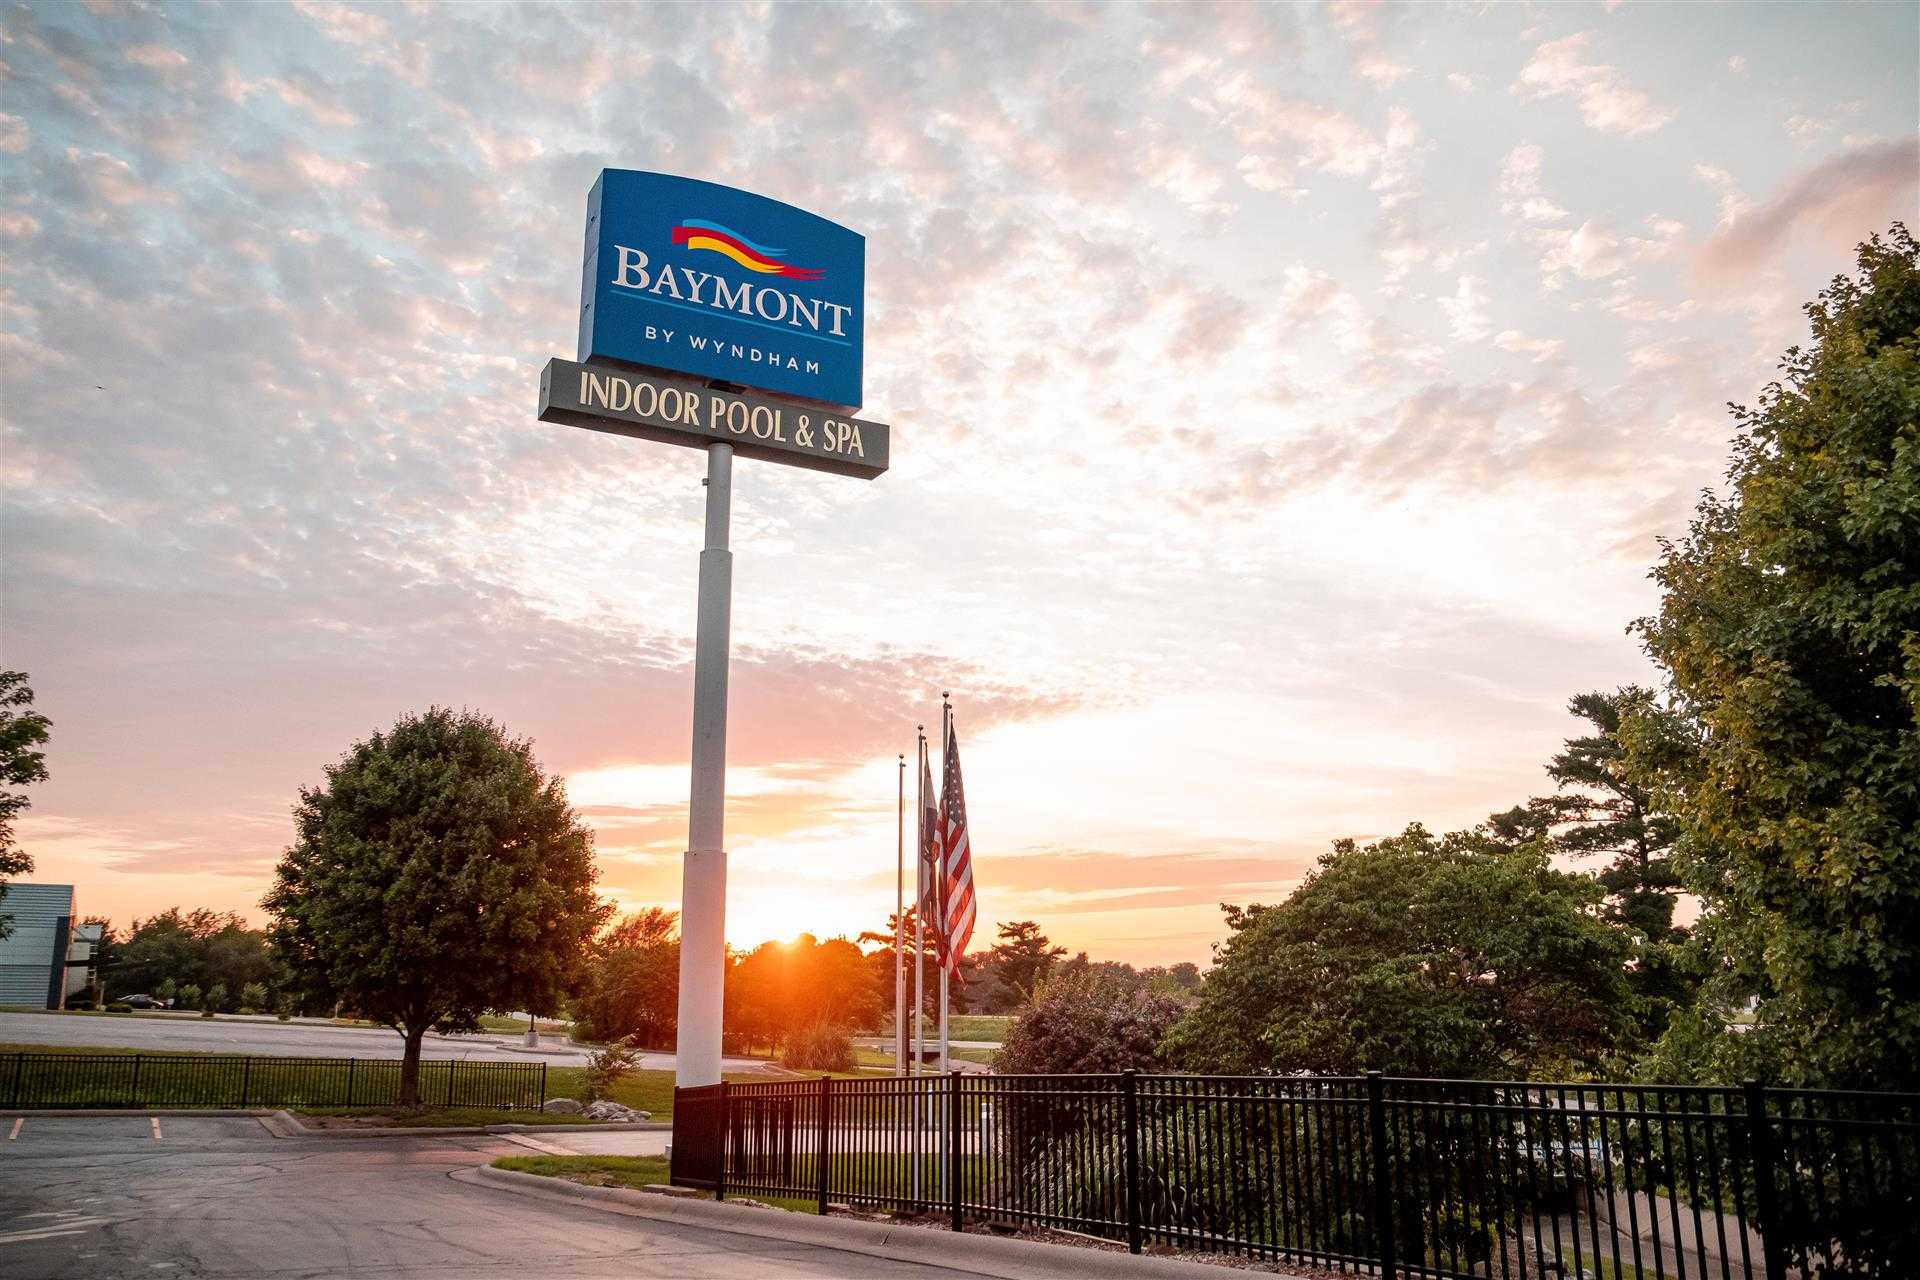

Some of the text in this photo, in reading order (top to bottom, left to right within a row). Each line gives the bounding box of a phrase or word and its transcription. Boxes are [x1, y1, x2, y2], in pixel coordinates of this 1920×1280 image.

[611, 244, 852, 337] BAYMONT
[645, 325, 820, 375] BY WYNDHAM
[579, 371, 865, 457] INDOOR POOL & SPA
